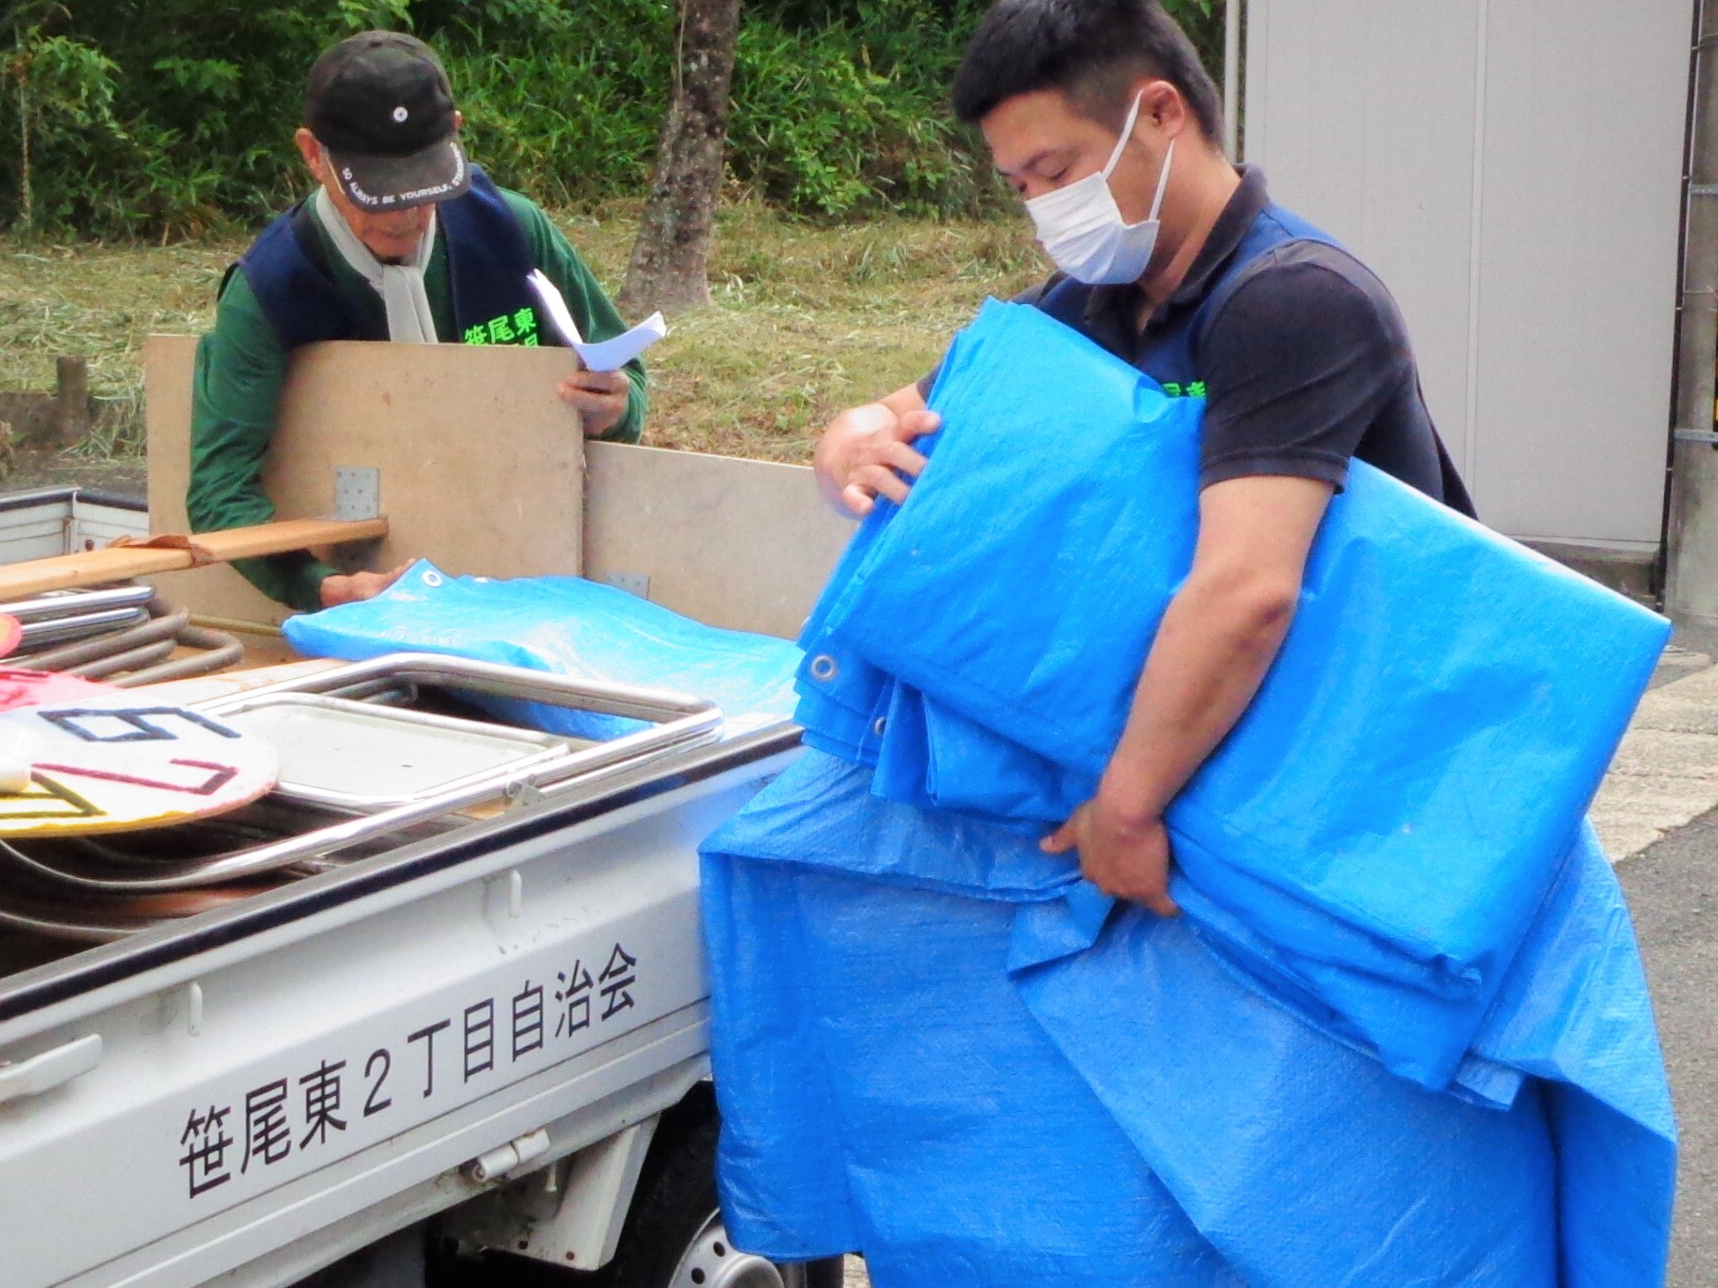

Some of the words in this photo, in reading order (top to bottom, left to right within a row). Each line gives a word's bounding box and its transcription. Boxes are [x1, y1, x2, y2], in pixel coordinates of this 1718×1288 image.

[382, 195, 395, 204] BE
[465, 308, 537, 346] 笹尾東
[179, 942, 637, 1199] 笹尾東2丁目自治会
